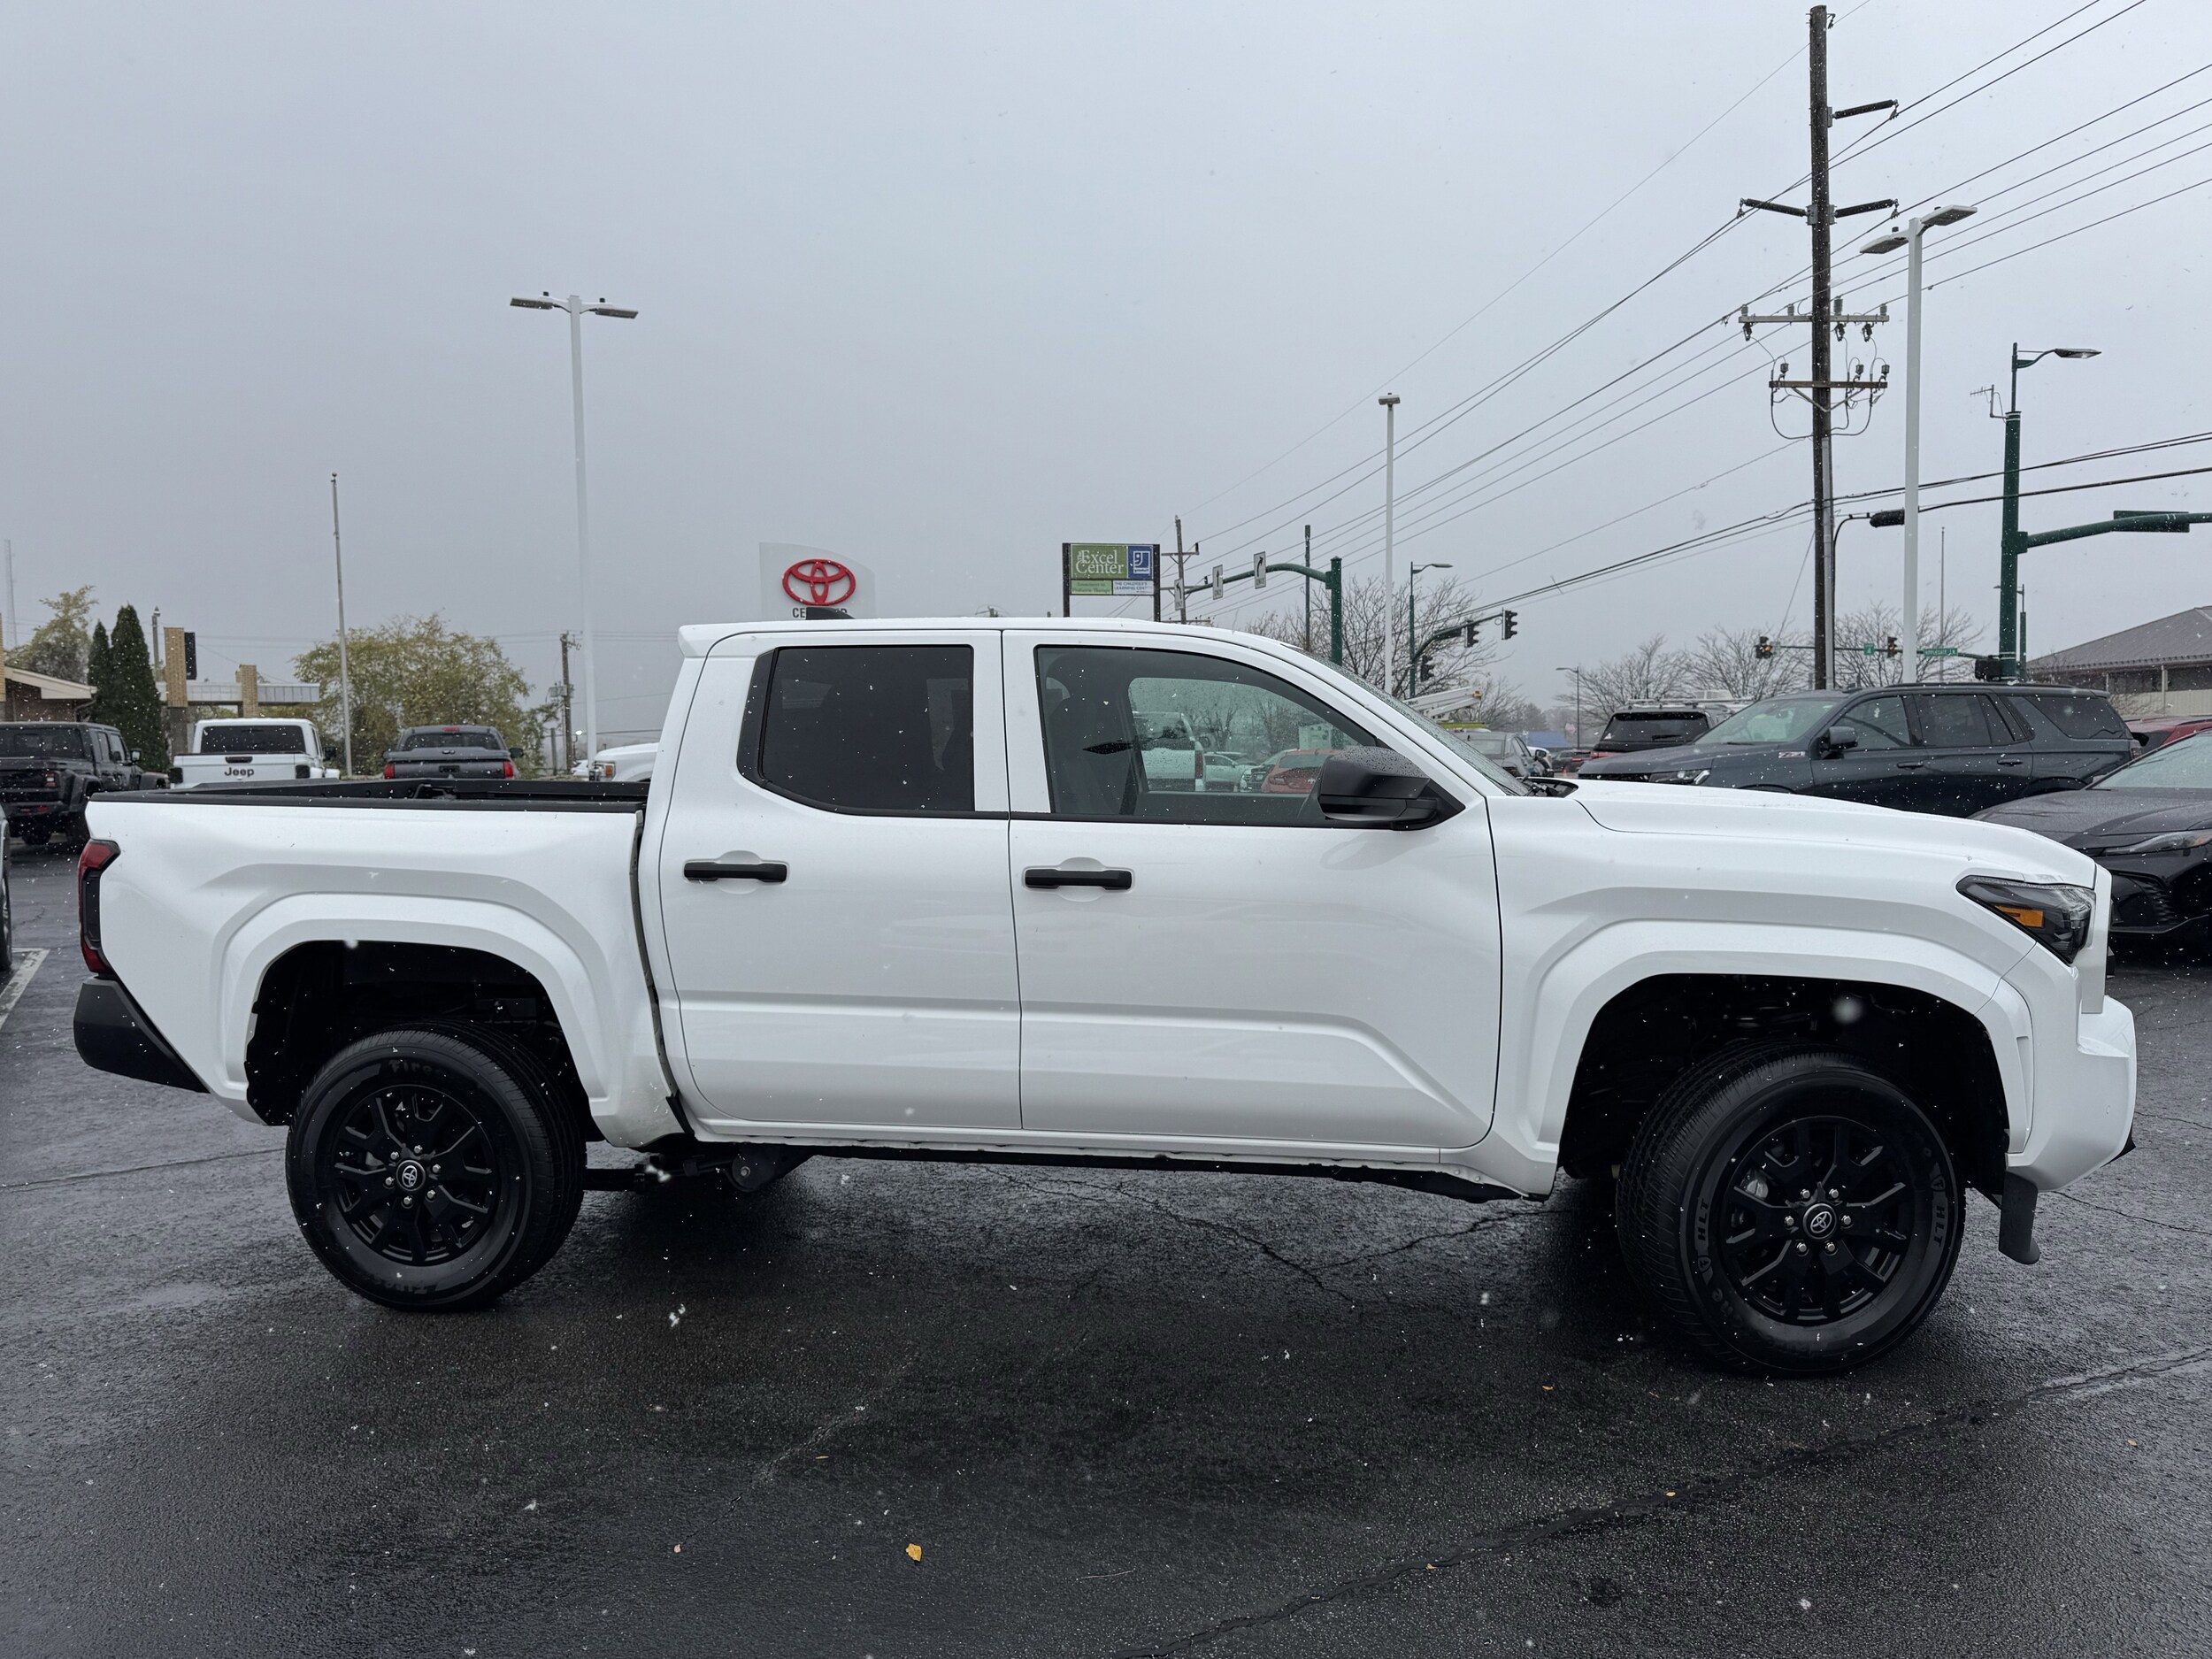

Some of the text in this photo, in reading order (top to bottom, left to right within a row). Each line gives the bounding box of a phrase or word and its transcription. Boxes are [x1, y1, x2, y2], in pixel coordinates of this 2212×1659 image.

[1080, 549, 1118, 565] Excel
[1076, 560, 1124, 574] Center
[225, 767, 254, 777] Jeep
